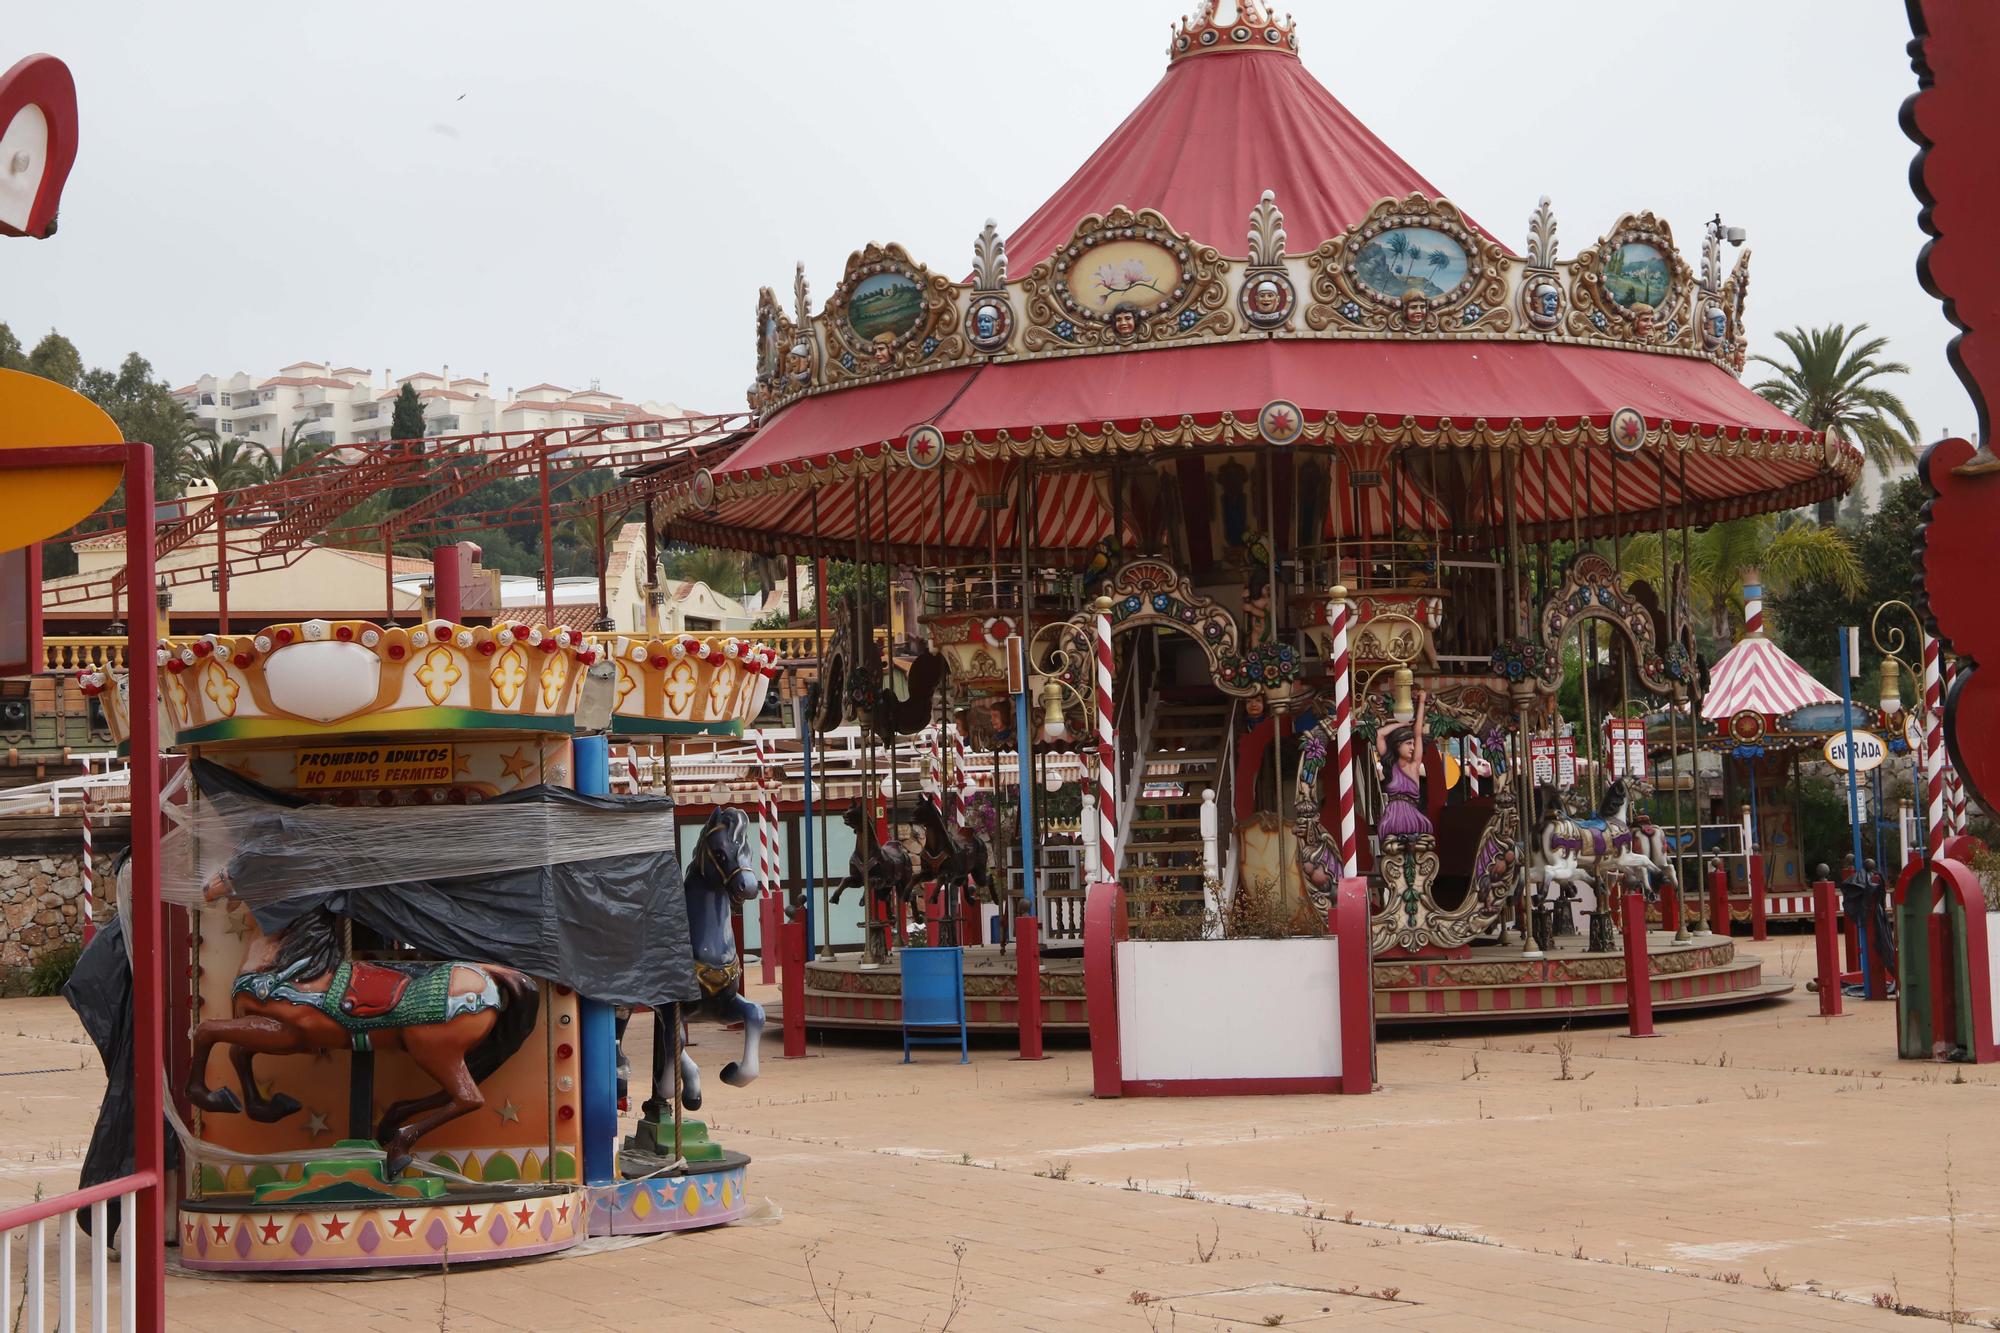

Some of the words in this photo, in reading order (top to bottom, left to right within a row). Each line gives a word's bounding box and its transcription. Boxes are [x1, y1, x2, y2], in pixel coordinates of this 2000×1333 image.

[300, 750, 380, 767] PROHIBIDO
[384, 748, 449, 763] ADULTOS
[1831, 741, 1882, 760] ENRADA
[305, 770, 326, 785] NO
[332, 768, 380, 783] ADULTS
[384, 766, 449, 782] PERMITED
